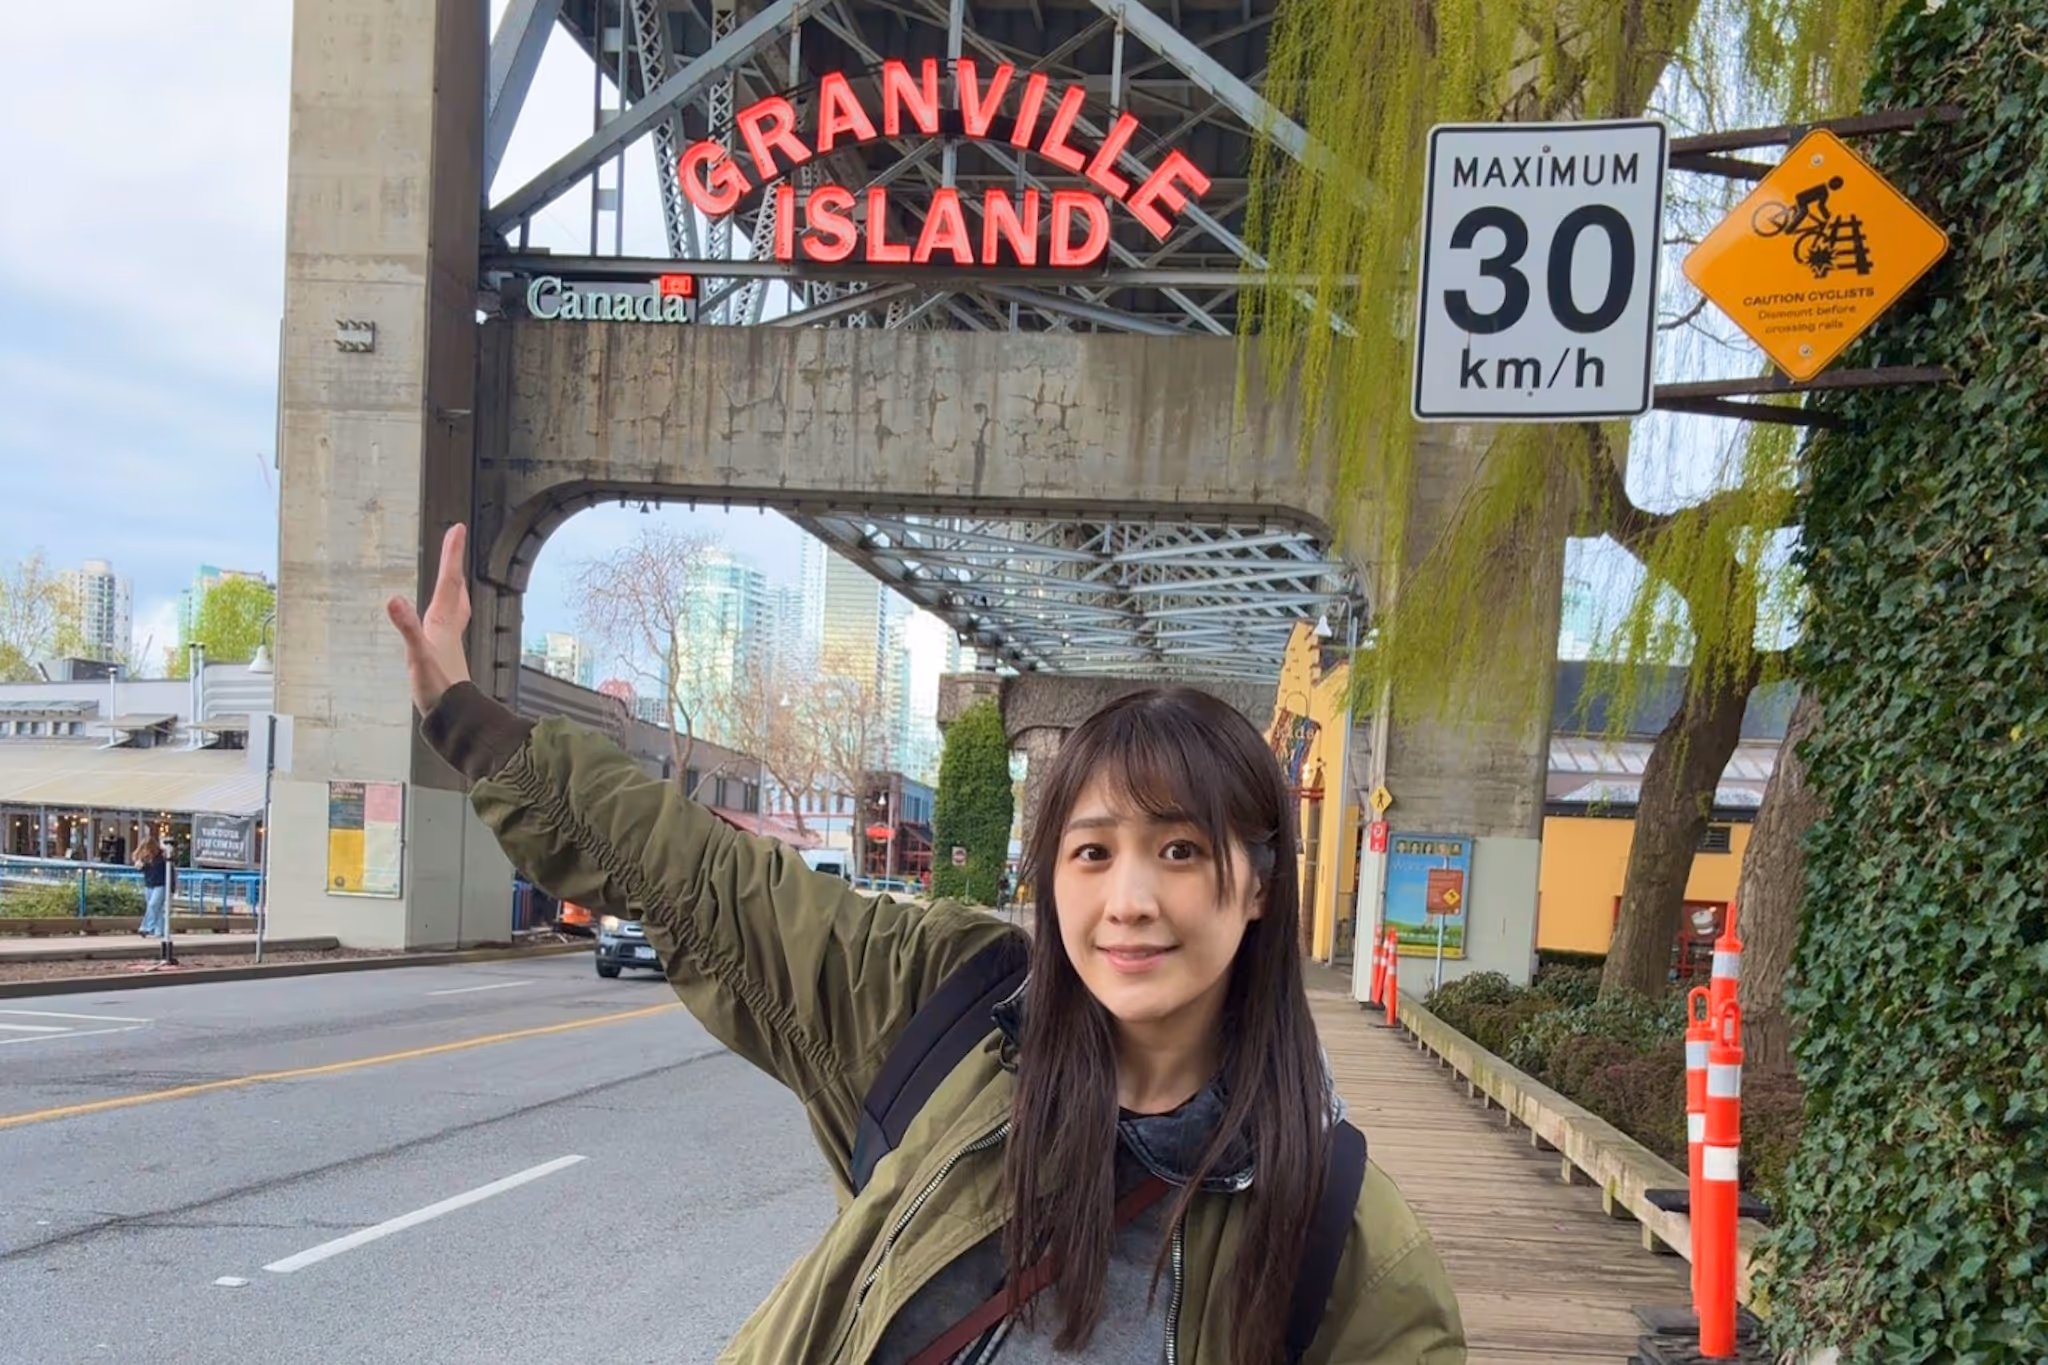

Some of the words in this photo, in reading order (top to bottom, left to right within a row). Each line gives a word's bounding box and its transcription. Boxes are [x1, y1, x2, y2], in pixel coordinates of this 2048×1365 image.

[677, 57, 1212, 243] GRANVILLE
[1453, 152, 1638, 188] MAXIMUM
[774, 185, 1110, 267] ISLAND
[1443, 203, 1635, 335] 30
[526, 275, 687, 322] Canada
[1743, 293, 1804, 306] CAUTION
[1808, 287, 1874, 301] CYCLISTS
[1759, 308, 1813, 320] Dismount
[1817, 305, 1856, 315] before
[1766, 323, 1816, 333] crossing
[1819, 320, 1843, 329] rails
[1459, 347, 1605, 389] km/h
